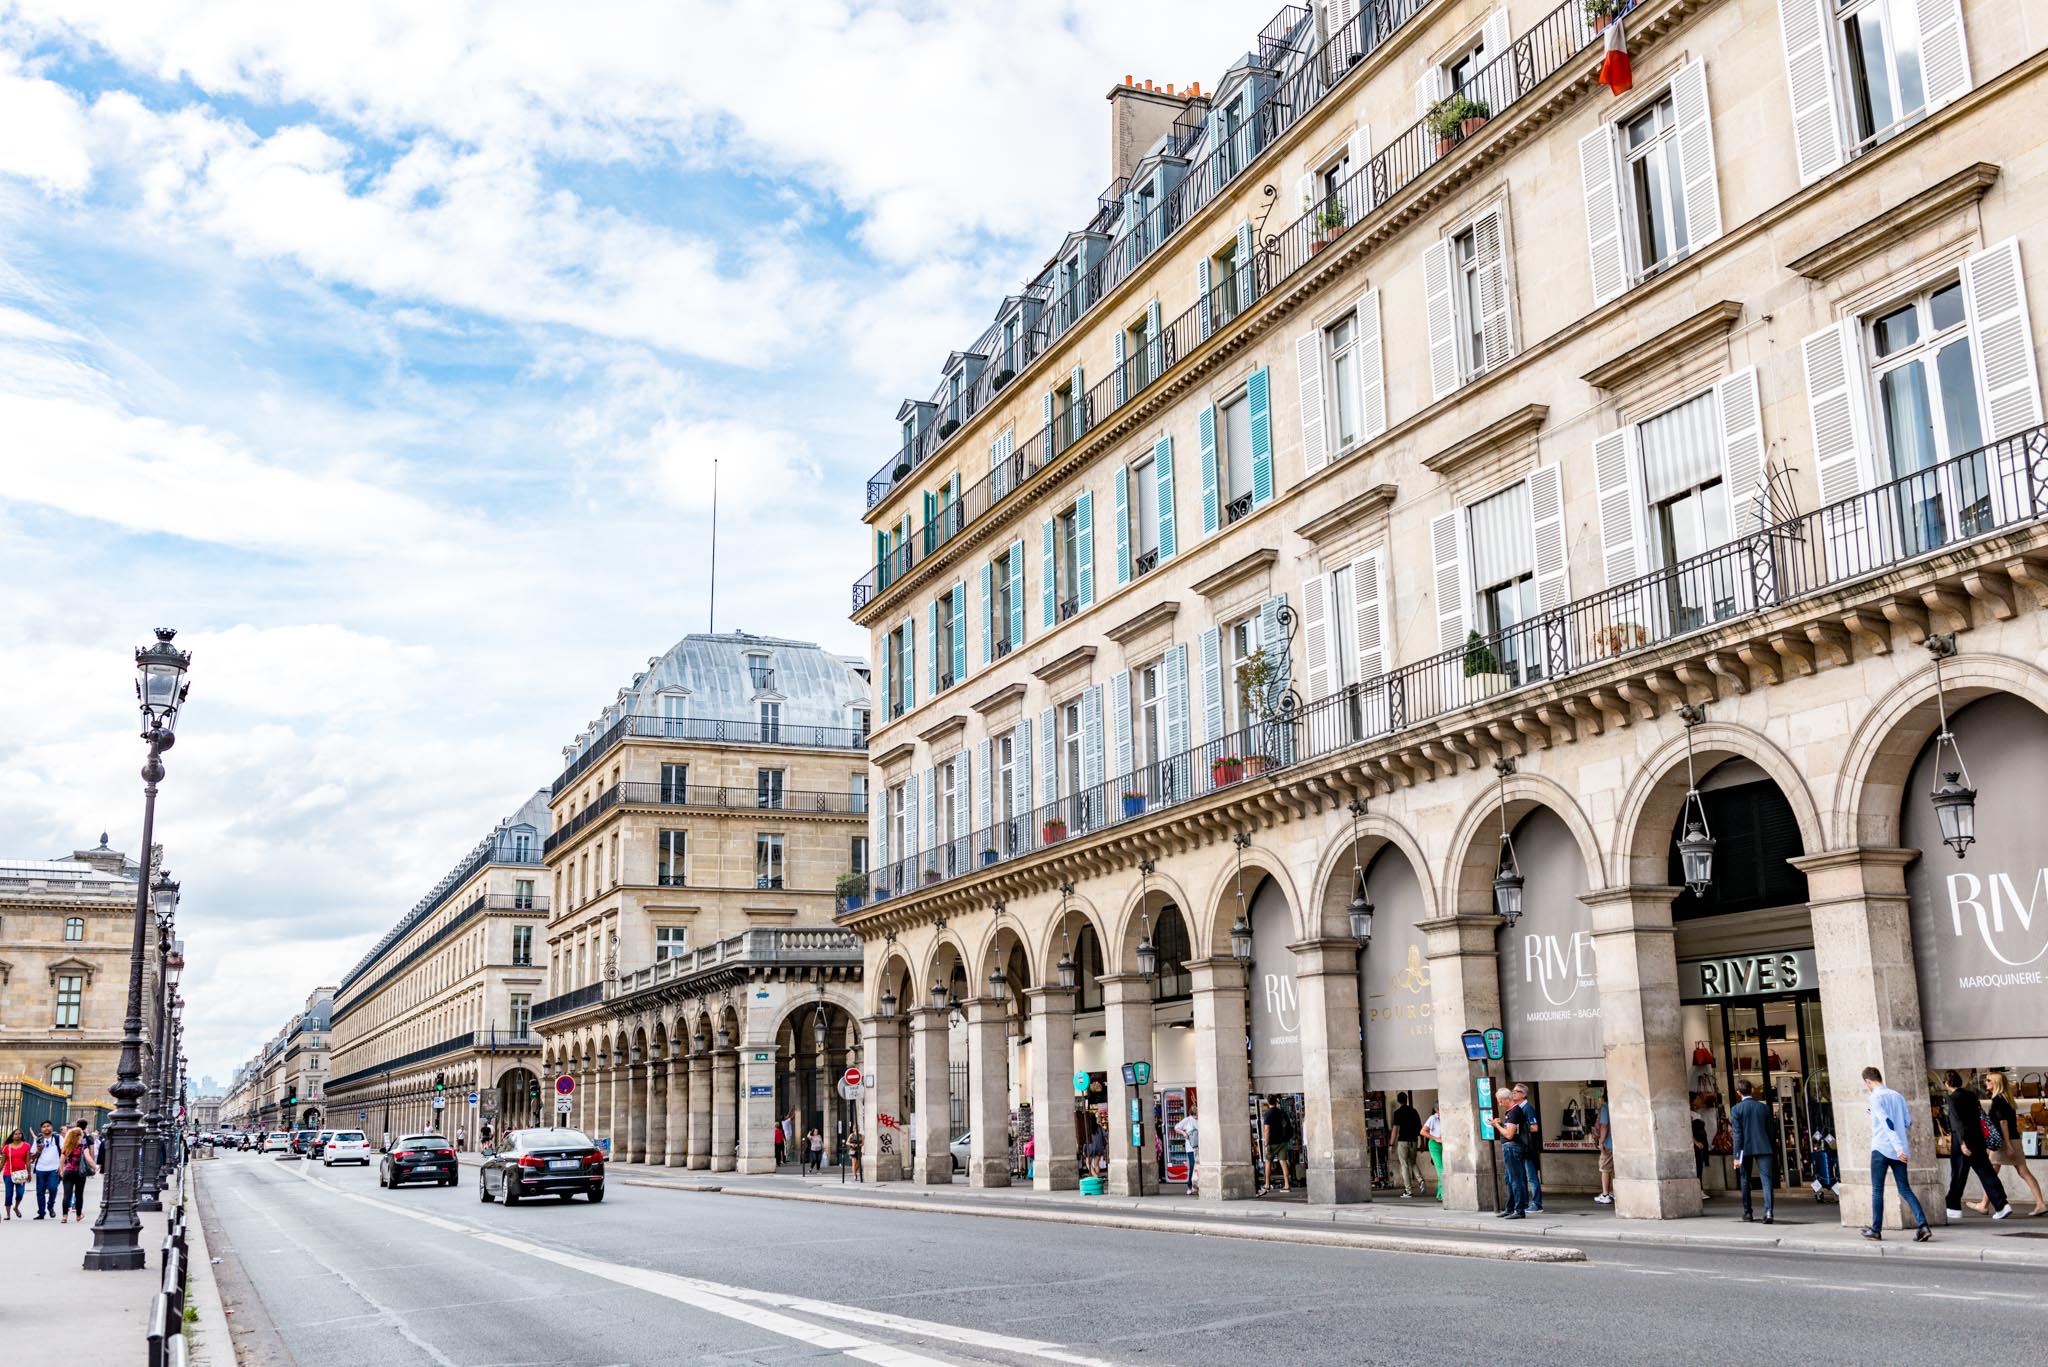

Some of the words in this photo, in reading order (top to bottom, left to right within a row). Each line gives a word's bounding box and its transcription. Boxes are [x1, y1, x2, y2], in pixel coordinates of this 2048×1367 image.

[1946, 867, 2048, 966] RIV
[1700, 955, 1798, 995] RIVES
[1959, 971, 2042, 989] MAROQUINERIE
[1526, 1010, 1571, 1022] MAROQUINERIE
